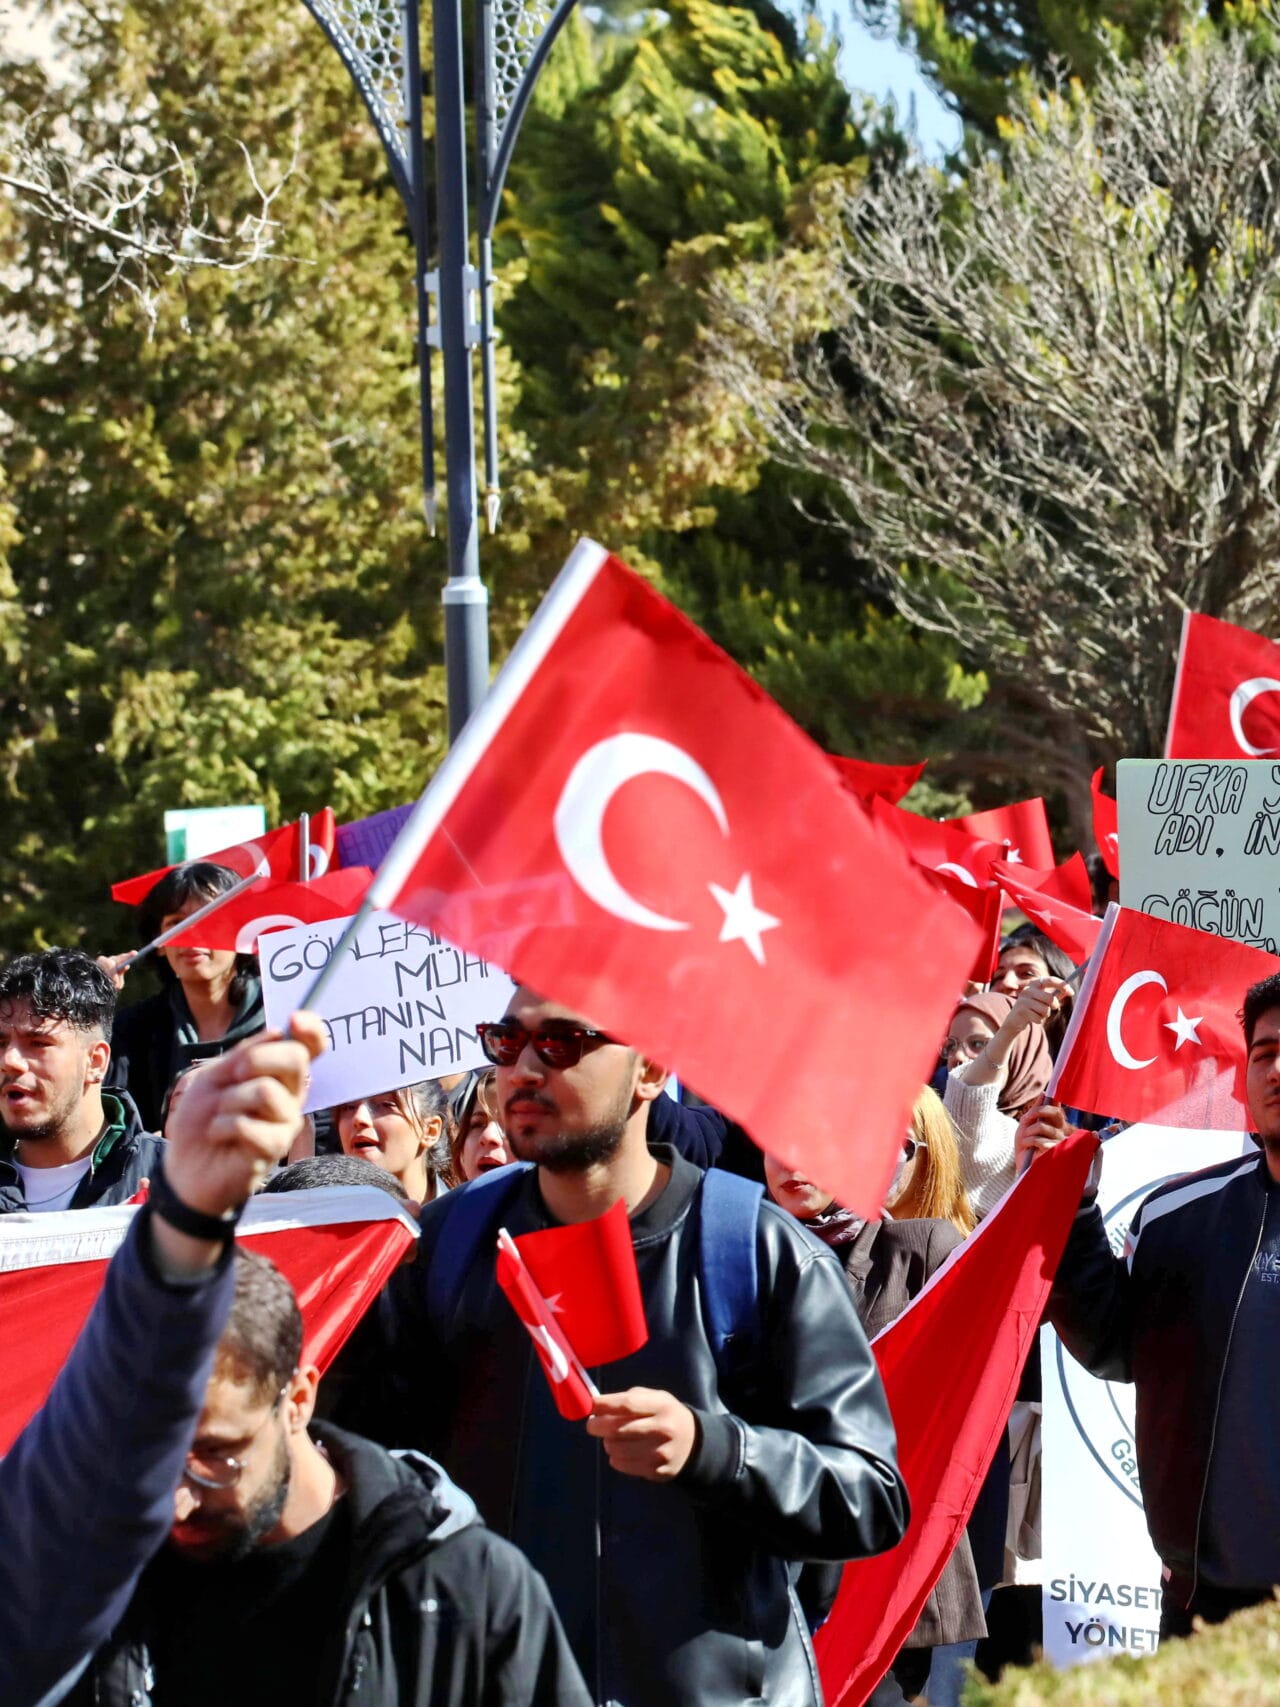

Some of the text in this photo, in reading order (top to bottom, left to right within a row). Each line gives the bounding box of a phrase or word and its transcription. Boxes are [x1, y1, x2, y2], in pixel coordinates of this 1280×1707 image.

[1147, 764, 1248, 814] UFKA
[1050, 1573, 1162, 1611] SİYASET
[1065, 1617, 1160, 1652] YÖNET
